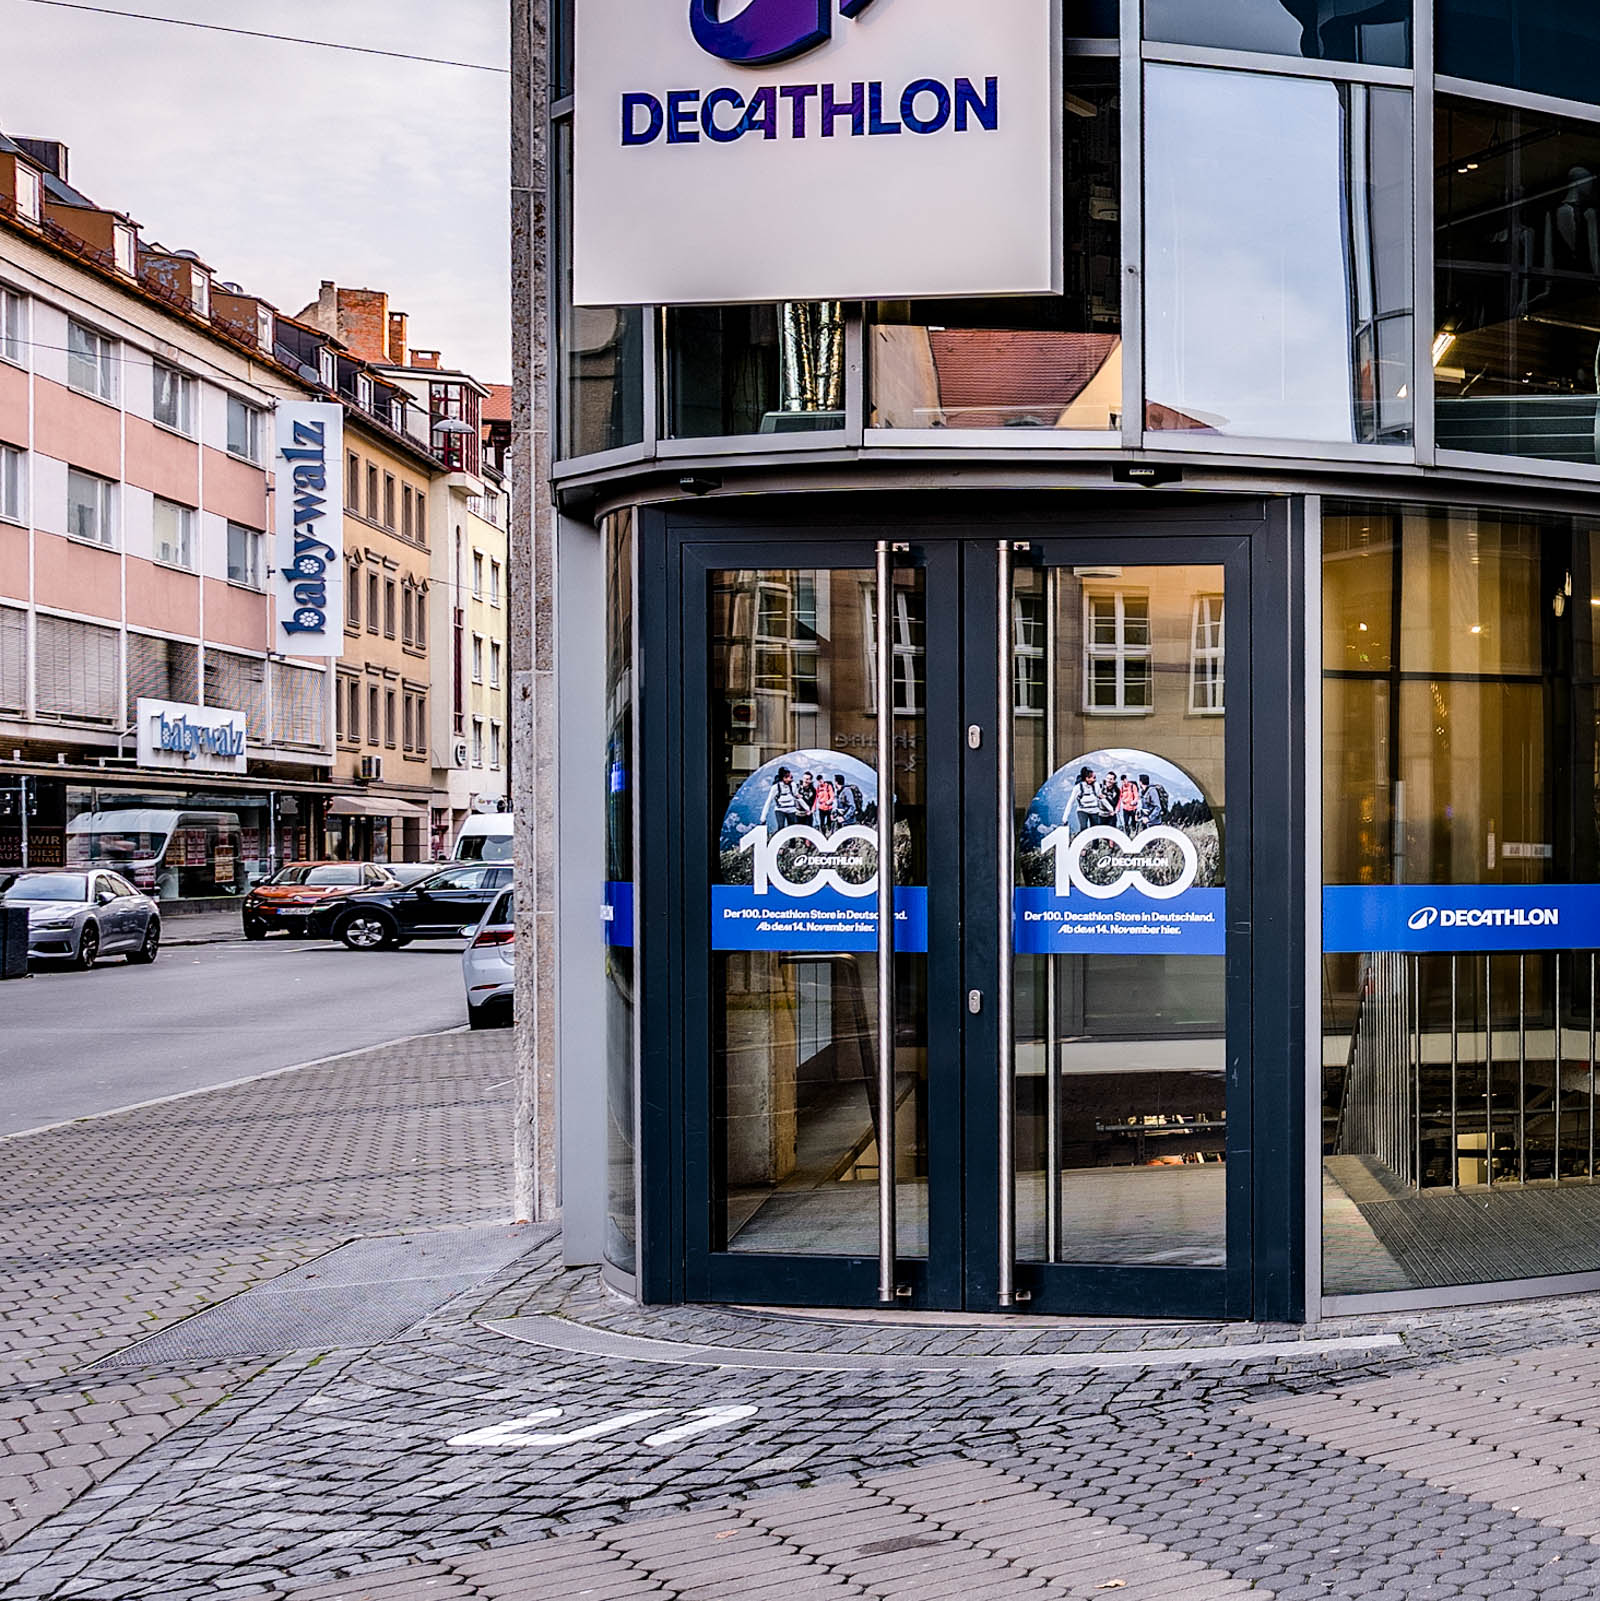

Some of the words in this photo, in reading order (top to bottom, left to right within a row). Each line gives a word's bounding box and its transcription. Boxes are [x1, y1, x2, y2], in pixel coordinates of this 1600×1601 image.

[621, 75, 998, 146] DECATHLON
[281, 420, 335, 635] baby-walz
[29, 835, 60, 845] WIR
[807, 856, 863, 867] DECATHLON
[1041, 825, 1197, 900] 100
[1112, 857, 1168, 867] DECATHLON
[724, 909, 742, 919] Der
[742, 909, 761, 919] 100.
[762, 909, 809, 919] Decathlon
[810, 909, 836, 919] Store
[837, 909, 846, 919] in
[1024, 912, 1043, 921] Der
[1043, 912, 1063, 922] 100.
[1064, 912, 1113, 921] Decathlon
[1114, 912, 1142, 922] Store
[1142, 912, 1151, 922] in
[1151, 912, 1215, 922] Deutschland.
[1440, 908, 1558, 926] DECATHLON
[756, 922, 771, 931] Ab
[792, 922, 805, 932] 14.
[807, 922, 854, 932] November
[855, 922, 875, 932] hier.
[1058, 925, 1074, 934] Ab
[1095, 925, 1110, 934] 14.
[1110, 925, 1159, 934] November
[1162, 925, 1181, 934] hier.
